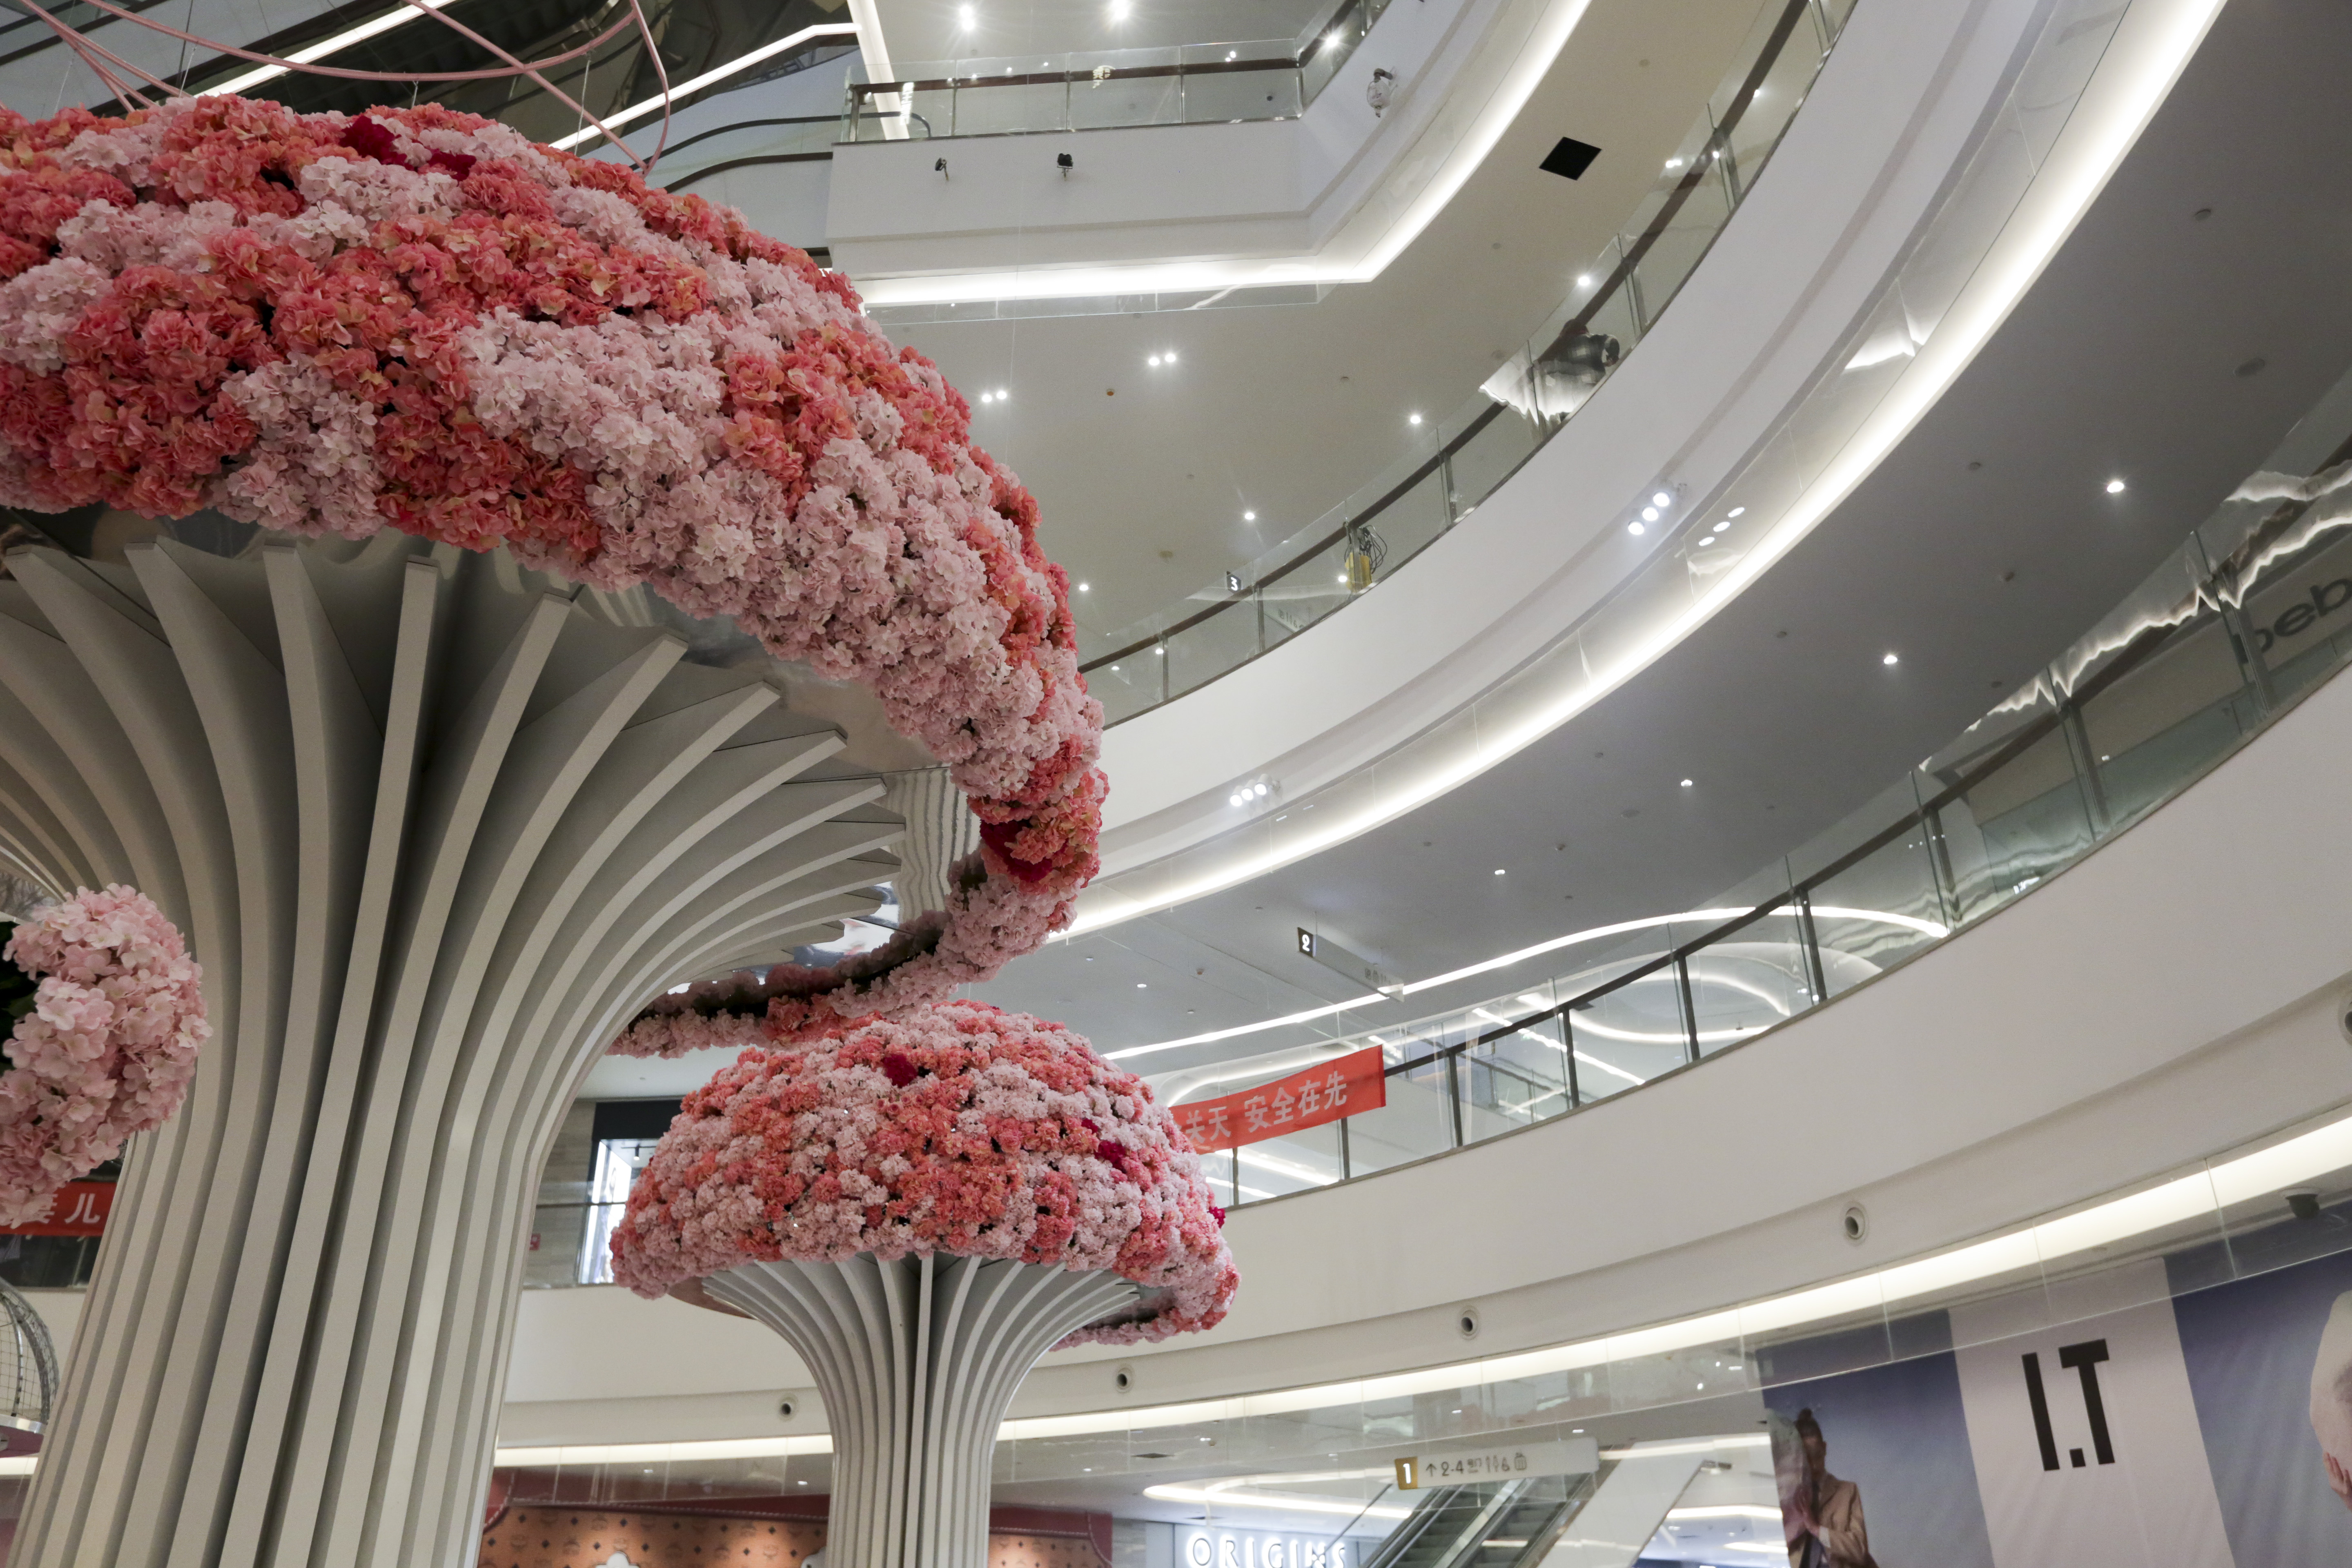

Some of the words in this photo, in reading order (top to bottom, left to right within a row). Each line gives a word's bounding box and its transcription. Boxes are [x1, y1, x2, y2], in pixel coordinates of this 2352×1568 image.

[1231, 577, 1238, 591] 3
[1302, 934, 1310, 951] 2
[1178, 1106, 1231, 1143] 关天
[1244, 1071, 1347, 1133] 安全在先
[2022, 1338, 2115, 1471] I.T
[1403, 1463, 1412, 1484] 1
[1188, 1533, 1346, 1568] ORIGINS
